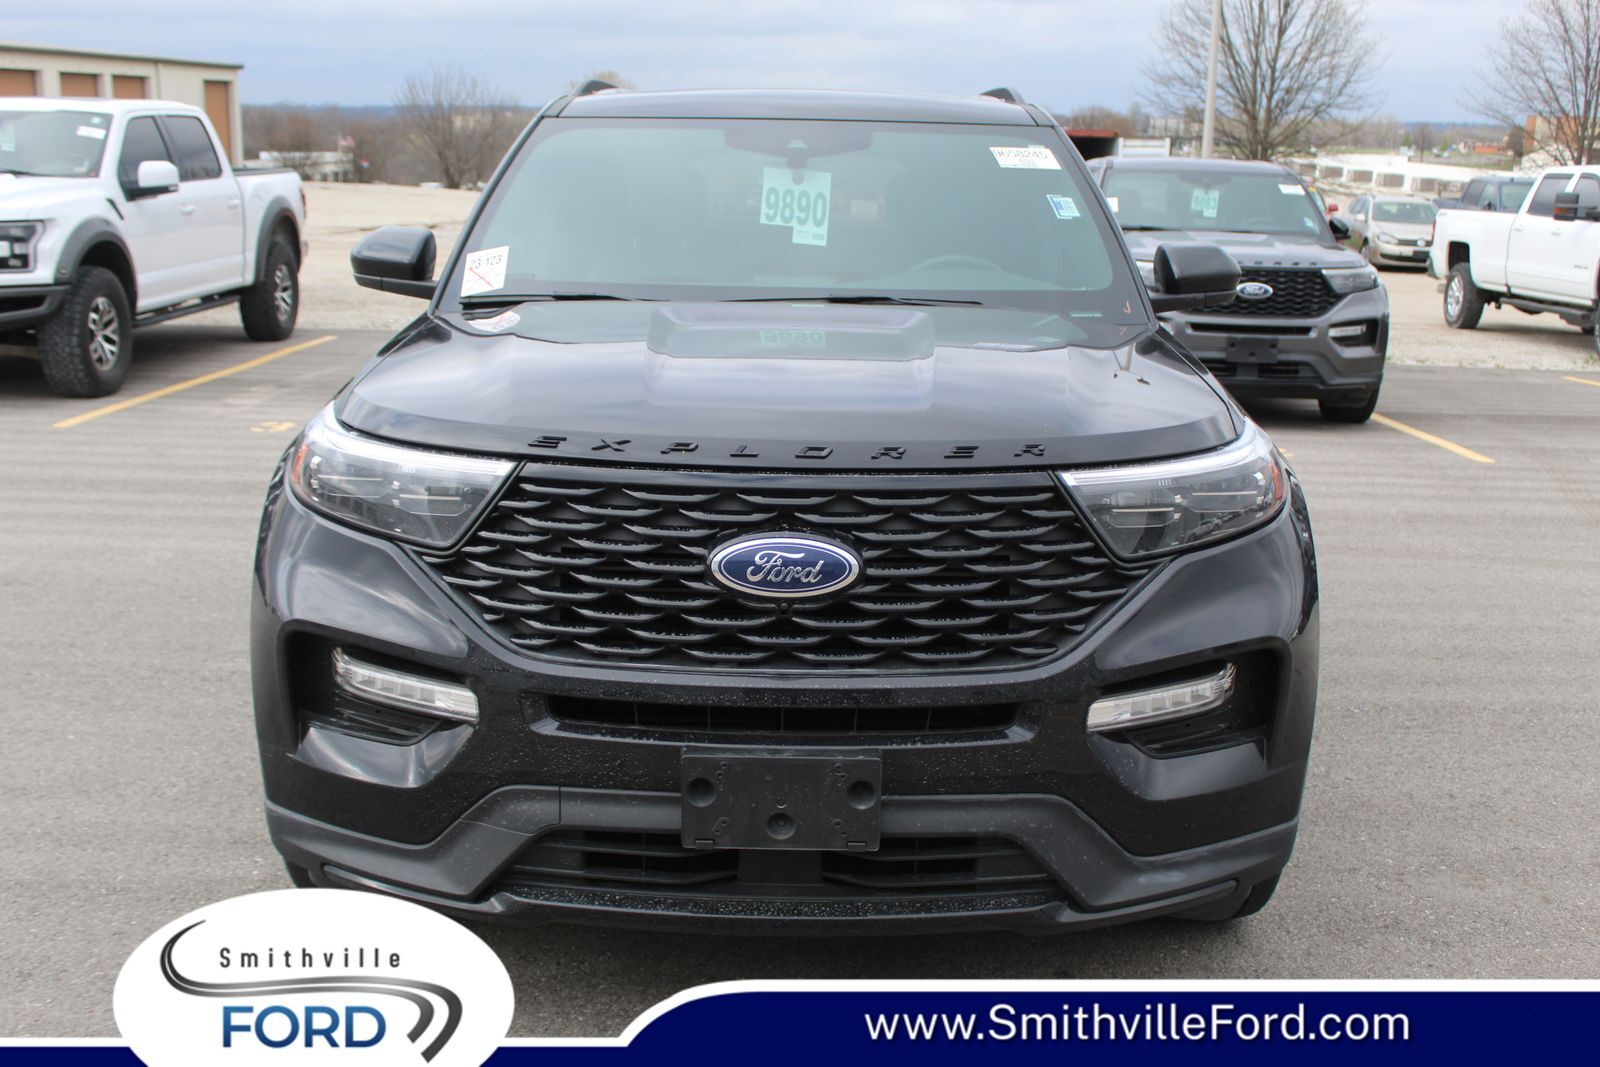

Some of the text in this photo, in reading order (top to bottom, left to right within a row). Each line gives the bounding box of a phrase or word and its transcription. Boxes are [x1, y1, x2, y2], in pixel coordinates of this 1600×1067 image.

[764, 186, 828, 228] 9890
[528, 435, 1047, 460] EXPLORER
[746, 550, 825, 583] Ford
